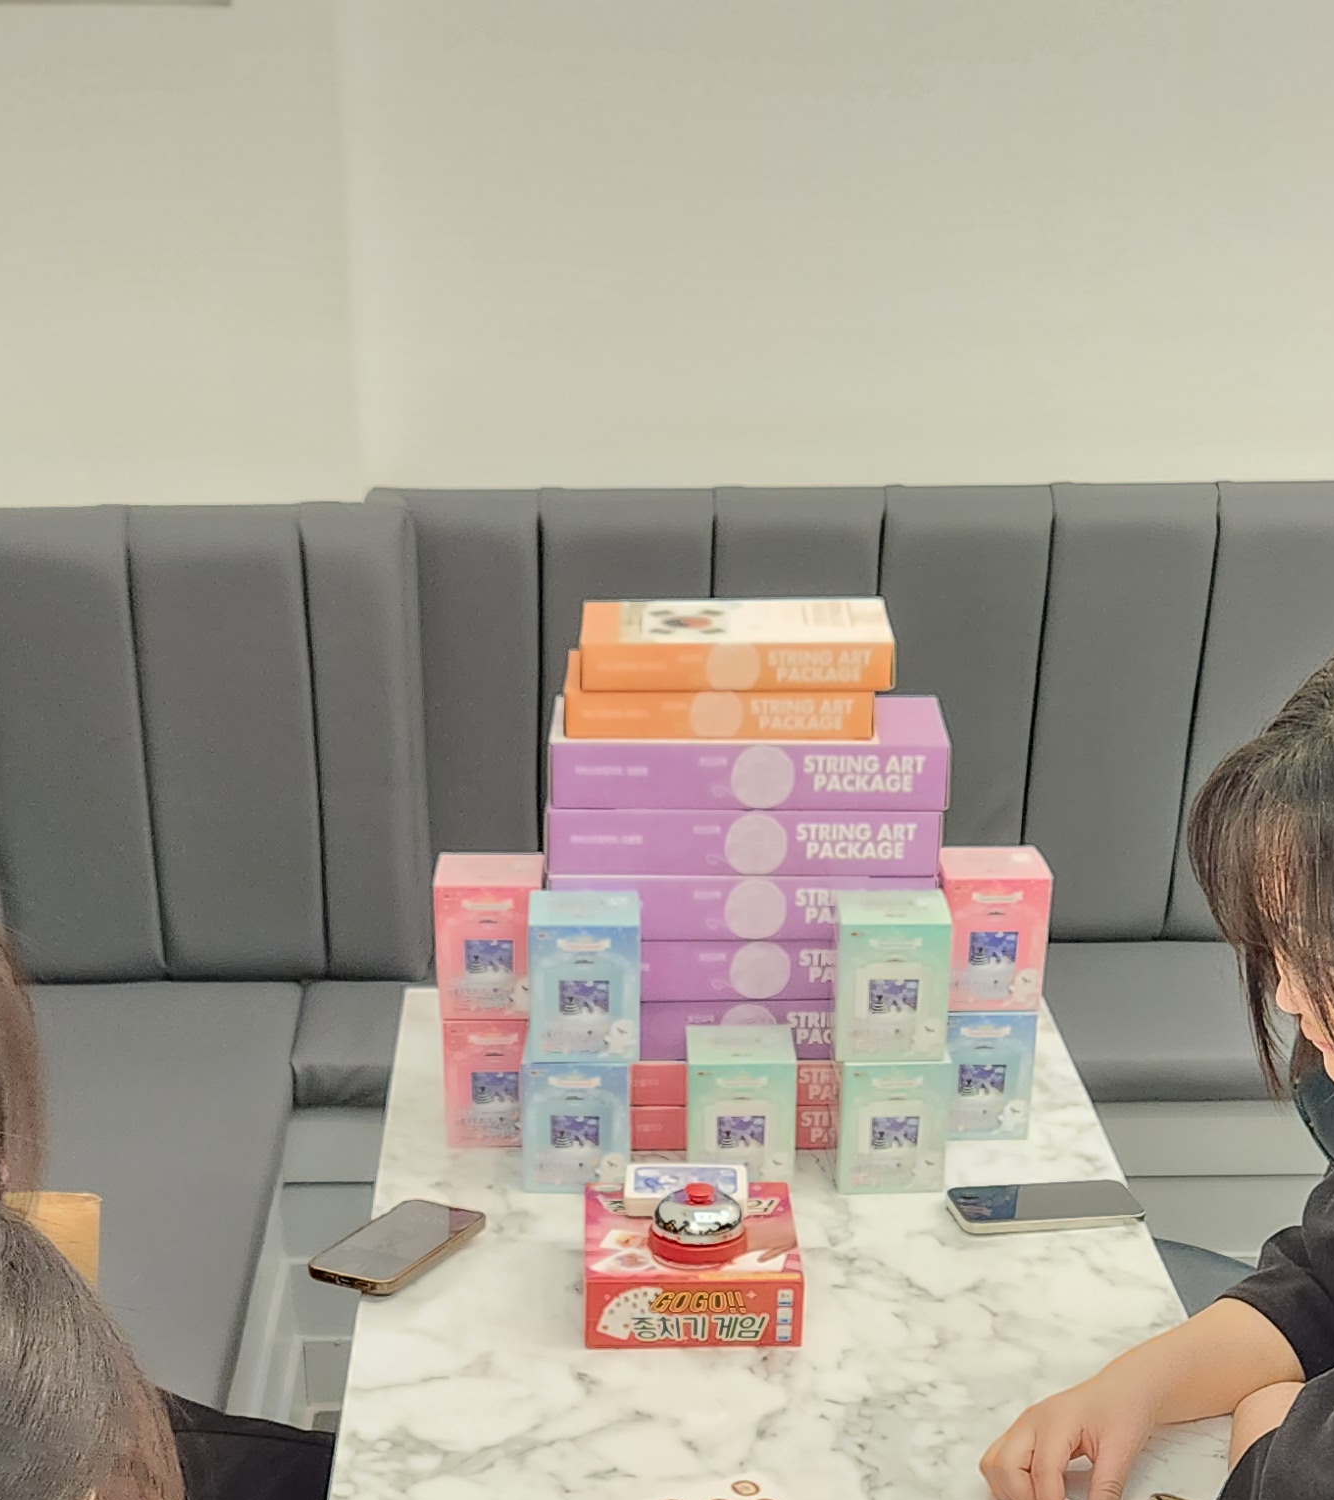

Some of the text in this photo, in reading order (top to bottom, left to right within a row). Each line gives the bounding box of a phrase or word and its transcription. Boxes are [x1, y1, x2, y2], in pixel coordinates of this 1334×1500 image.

[768, 650, 873, 668] STRING ART
[776, 667, 862, 683] PACKAGE
[750, 699, 854, 716] STRING ART
[758, 714, 843, 731] PACKAGE
[803, 755, 927, 774] STRING ART
[813, 774, 914, 793] PACKAGE
[796, 823, 917, 842] STRING ART
[806, 841, 905, 860] PACKAGE
[649, 1290, 747, 1314] GOGO!!
[630, 1314, 707, 1340] 종치기
[712, 1314, 768, 1340] 게임
